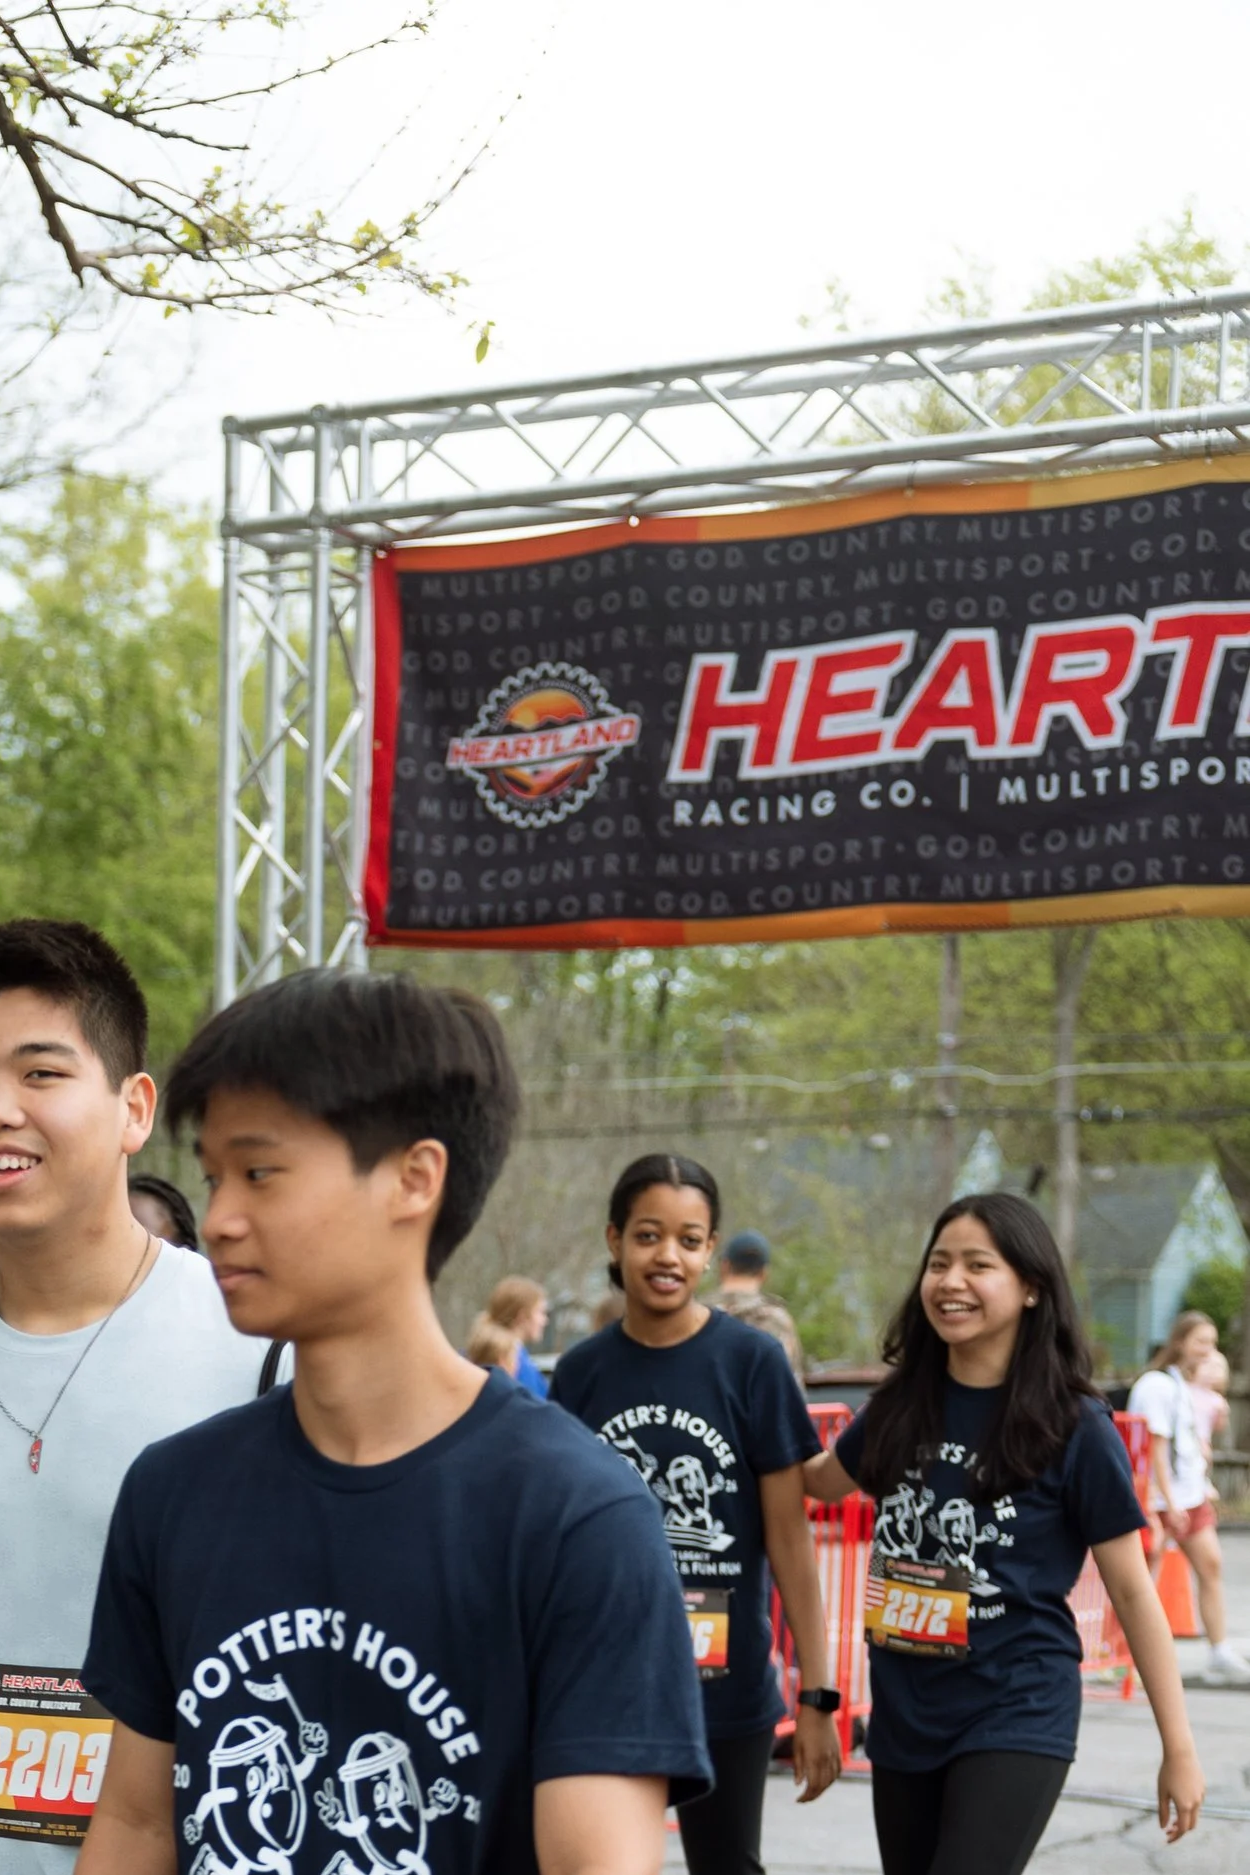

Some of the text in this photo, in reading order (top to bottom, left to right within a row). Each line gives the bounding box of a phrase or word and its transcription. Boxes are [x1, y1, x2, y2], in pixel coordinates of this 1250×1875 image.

[956, 490, 1214, 541] MULTISPORT
[853, 547, 1095, 590] MULTISPORT
[664, 602, 896, 646] MULTISPORT
[665, 600, 1250, 783] HEART
[451, 718, 638, 764] HEARTLAND
[673, 789, 837, 827] RACING
[860, 779, 933, 811] CO.
[655, 836, 886, 877] MULTISPORT
[940, 853, 1187, 899] MULTISPORT
[671, 1408, 736, 1469] HOUSE
[691, 1561, 717, 1576] FUN
[718, 1561, 742, 1576] RUN
[881, 1588, 953, 1636] 2272
[978, 1603, 1006, 1620] RUN
[2, 1674, 87, 1692] HEARTLAN
[176, 1607, 480, 1764] POTTER'S HOUSE
